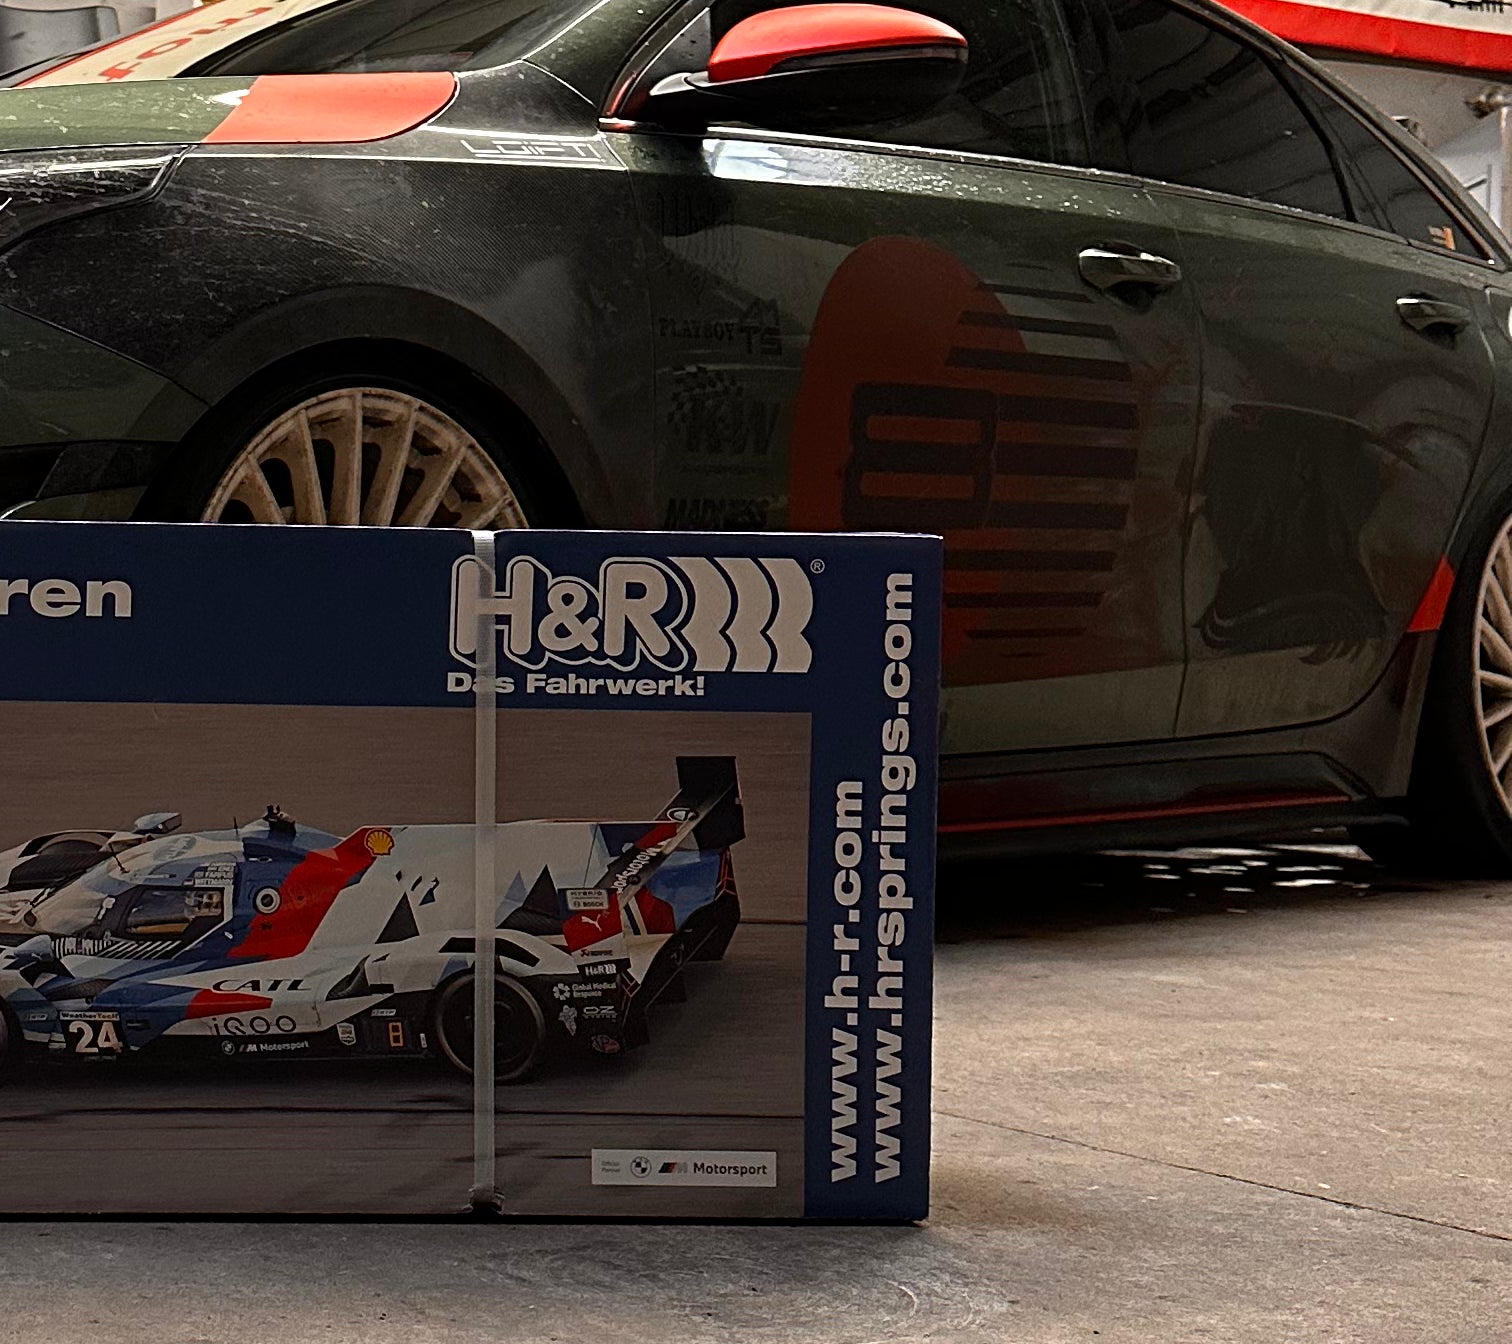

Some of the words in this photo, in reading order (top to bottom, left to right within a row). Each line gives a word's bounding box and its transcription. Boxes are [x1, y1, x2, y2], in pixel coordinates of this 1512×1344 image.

[449, 554, 689, 672] H&R
[526, 673, 705, 697] Fahrwerk!
[868, 571, 918, 1184] www.hrsprings.com
[211, 978, 313, 993] CATL
[823, 780, 865, 1184] www.h-r.com
[68, 1020, 124, 1054] 24
[259, 1039, 310, 1054] Motorsport
[693, 1161, 768, 1177] Motorsport
